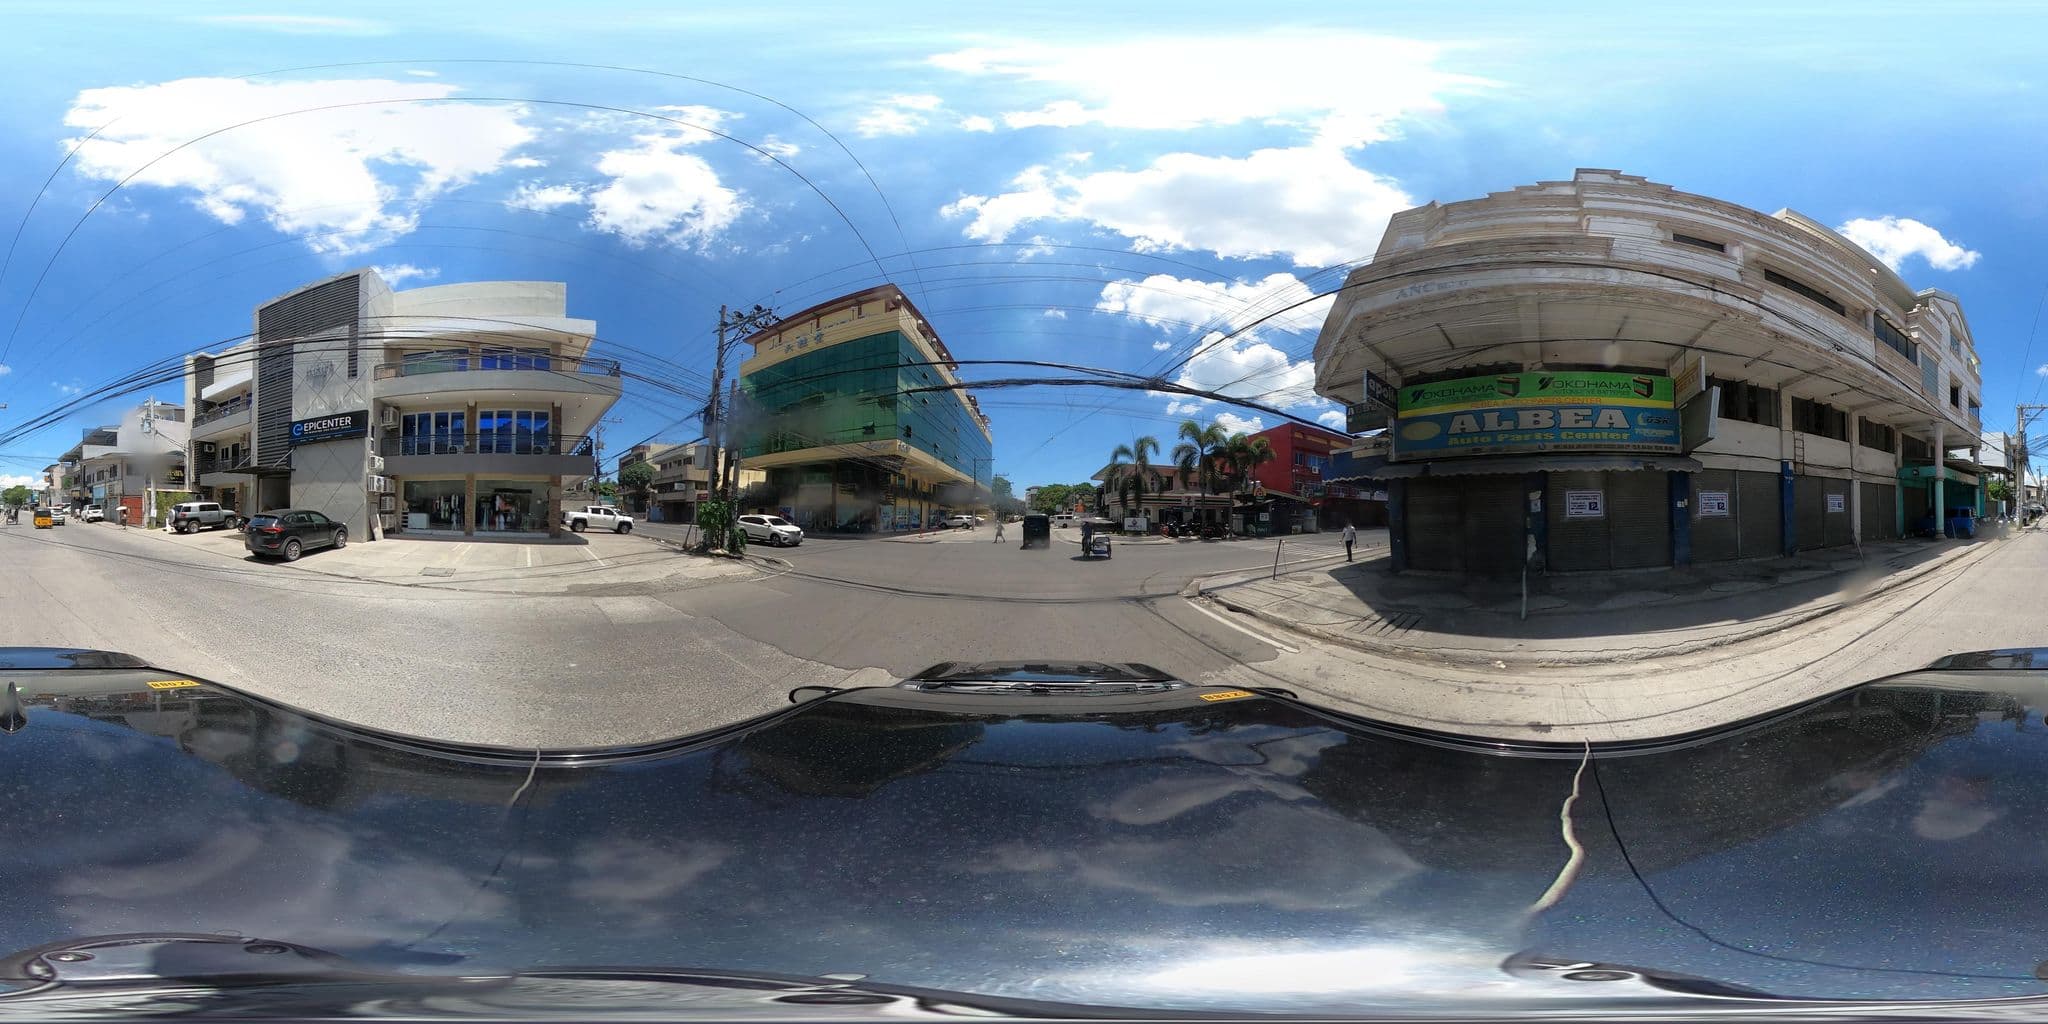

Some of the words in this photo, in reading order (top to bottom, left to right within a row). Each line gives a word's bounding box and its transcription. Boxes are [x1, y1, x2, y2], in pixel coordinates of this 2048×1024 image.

[1538, 377, 1631, 391] YOKOHAMA
[303, 416, 352, 431] EPICENTER
[1447, 409, 1631, 434] ALBEA
[1448, 435, 1491, 446] Auto
[1497, 433, 1555, 442] Parts
[1560, 432, 1631, 441] Center
